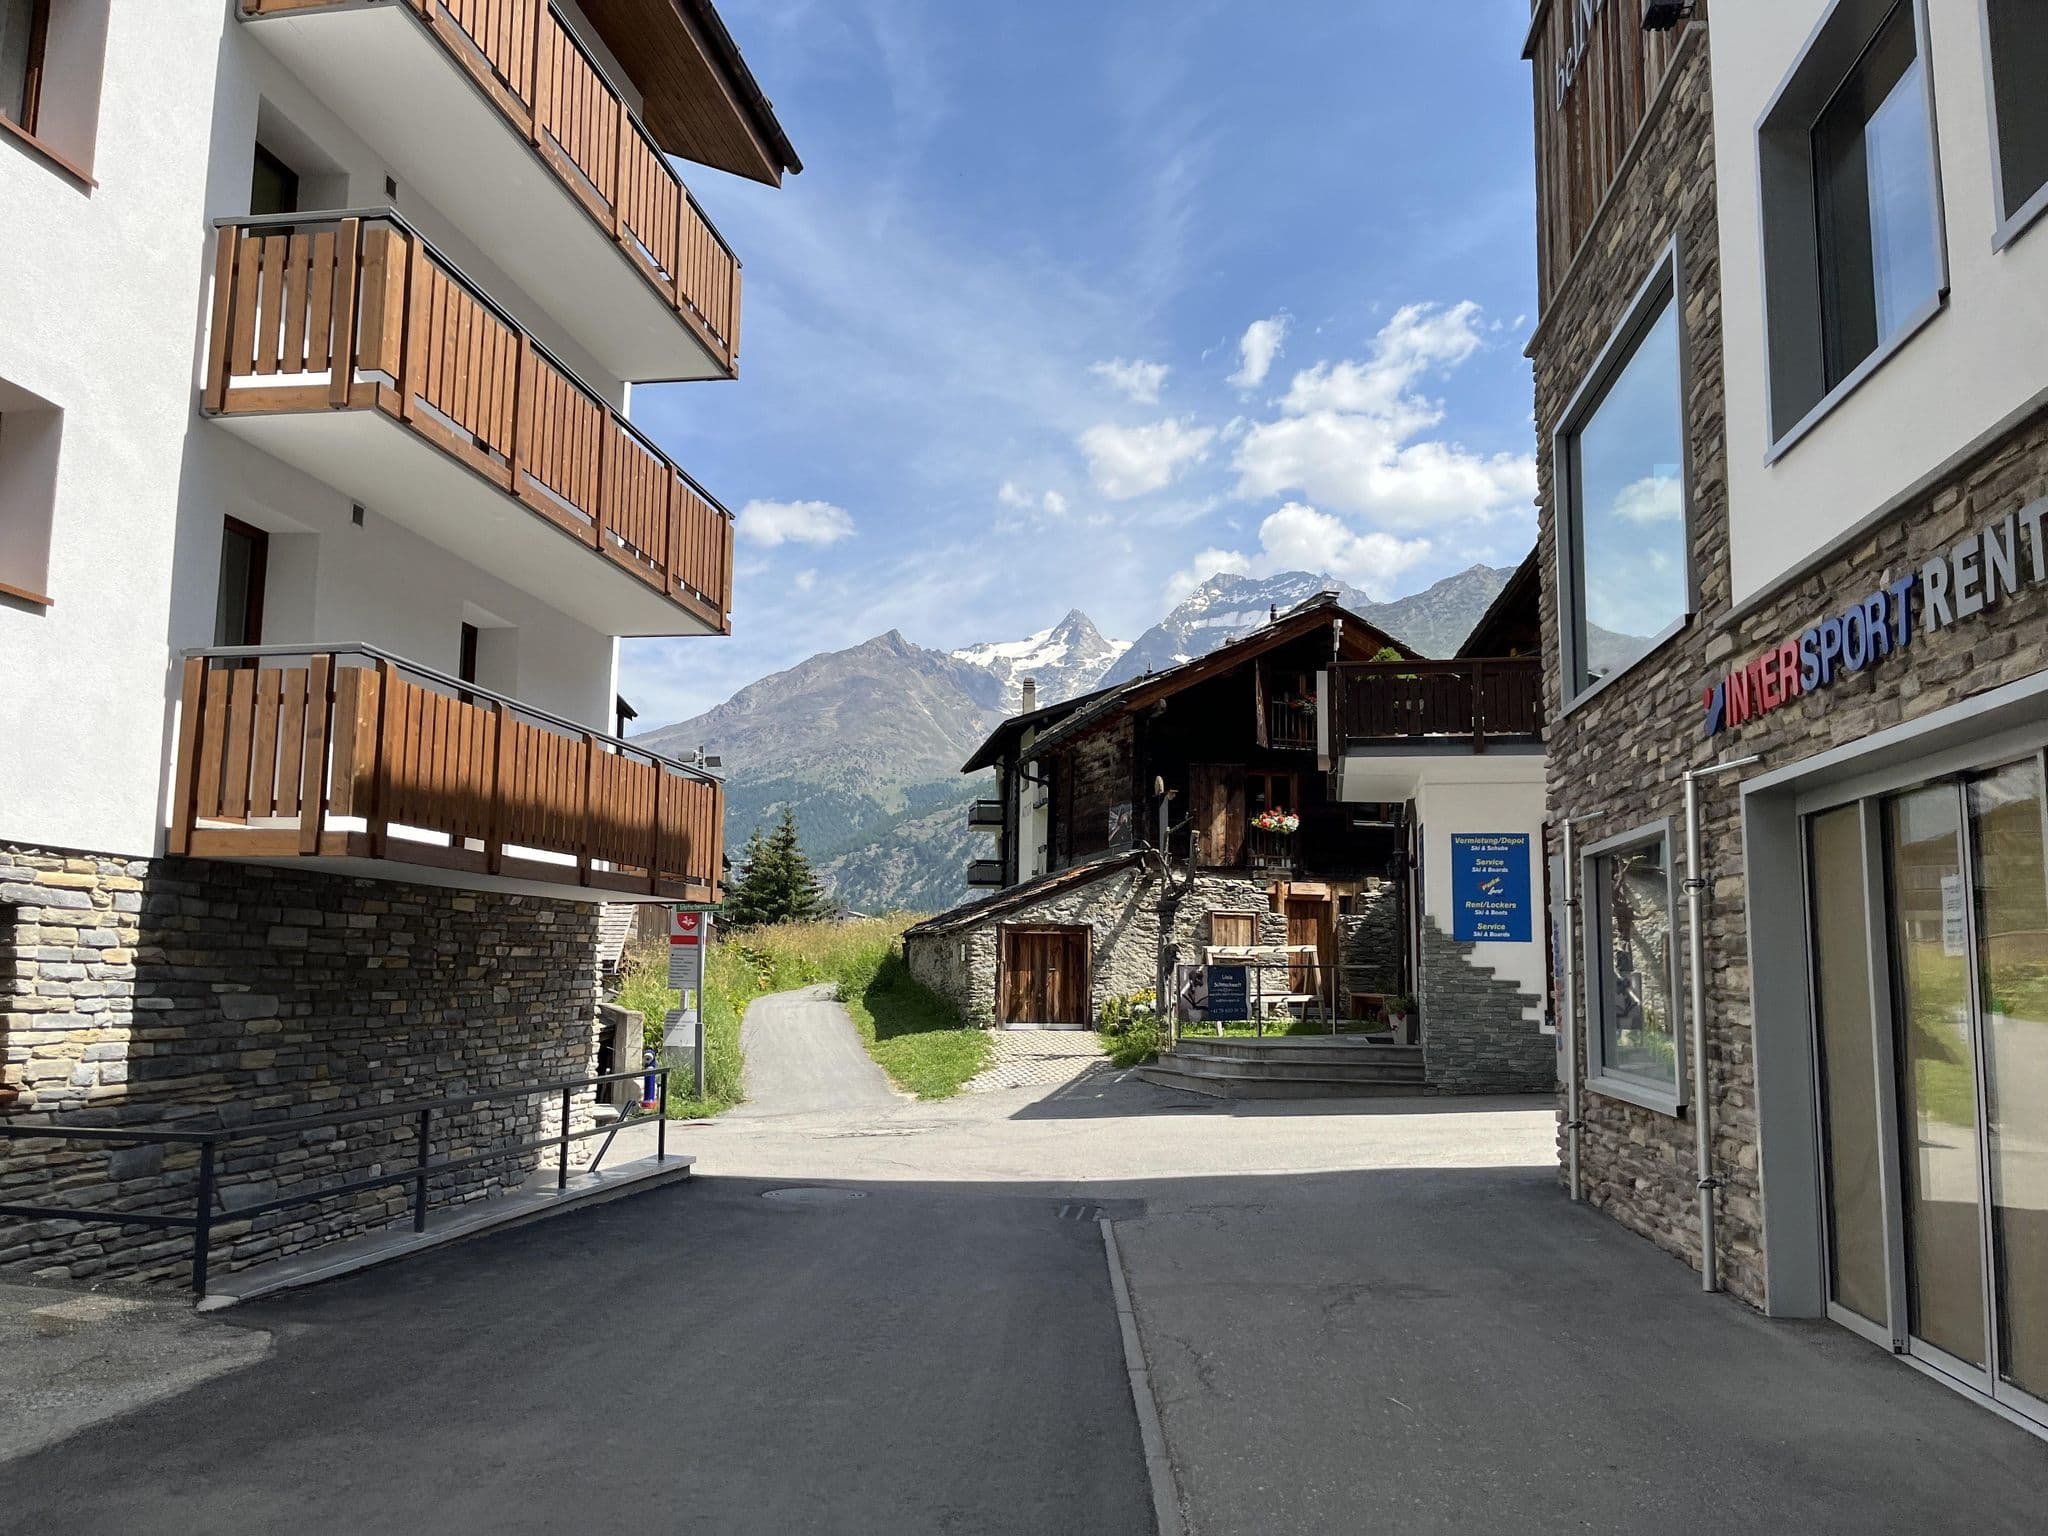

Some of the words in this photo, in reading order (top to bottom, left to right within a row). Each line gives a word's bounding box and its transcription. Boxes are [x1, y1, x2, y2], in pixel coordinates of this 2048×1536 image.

[1725, 574, 1917, 728] INTERSPORT
[1922, 495, 2048, 633] RENT
[1455, 837, 1525, 845] Vermietung/Depot
[1475, 858, 1504, 866] Service
[1465, 901, 1517, 909] Rent/Lockers
[1477, 922, 1506, 930] Service
